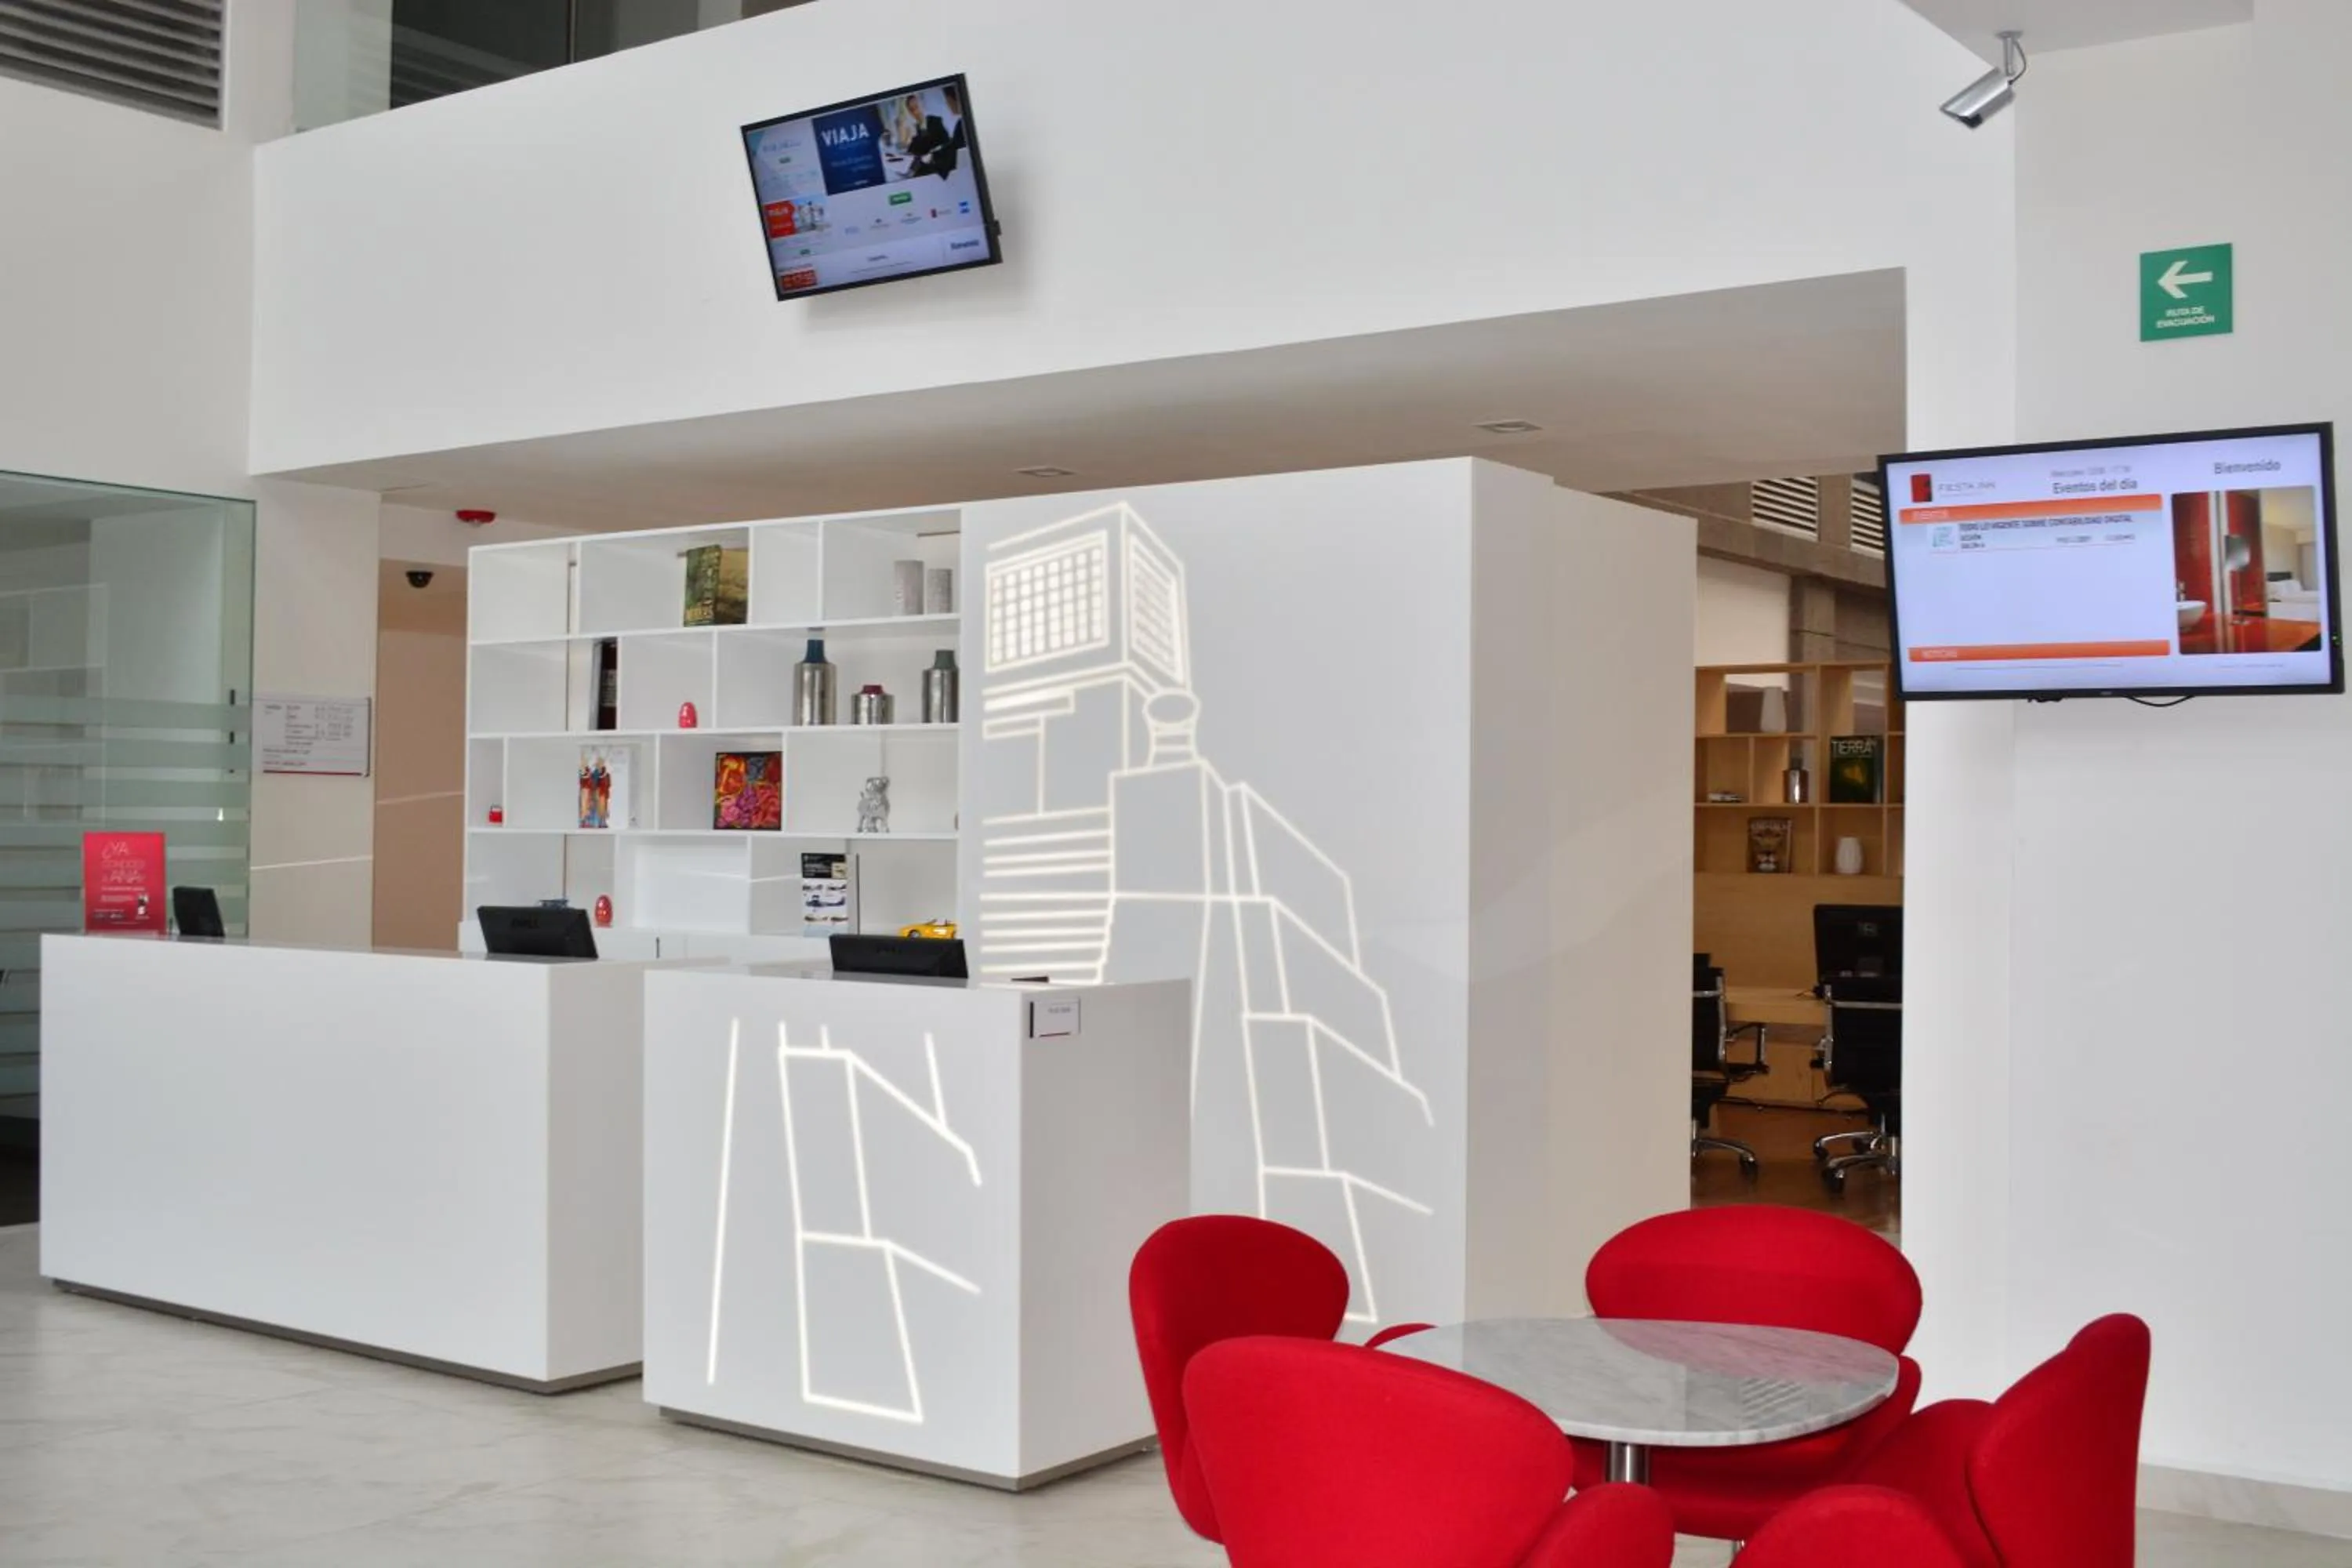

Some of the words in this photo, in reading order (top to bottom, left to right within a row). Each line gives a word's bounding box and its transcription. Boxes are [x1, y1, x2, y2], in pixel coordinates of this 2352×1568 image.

[821, 123, 870, 147] VIAJA
[2191, 306, 2205, 314] DE
[2214, 459, 2281, 475] Bienvenido
[2052, 482, 2096, 495] Eventos
[2099, 479, 2117, 492] del
